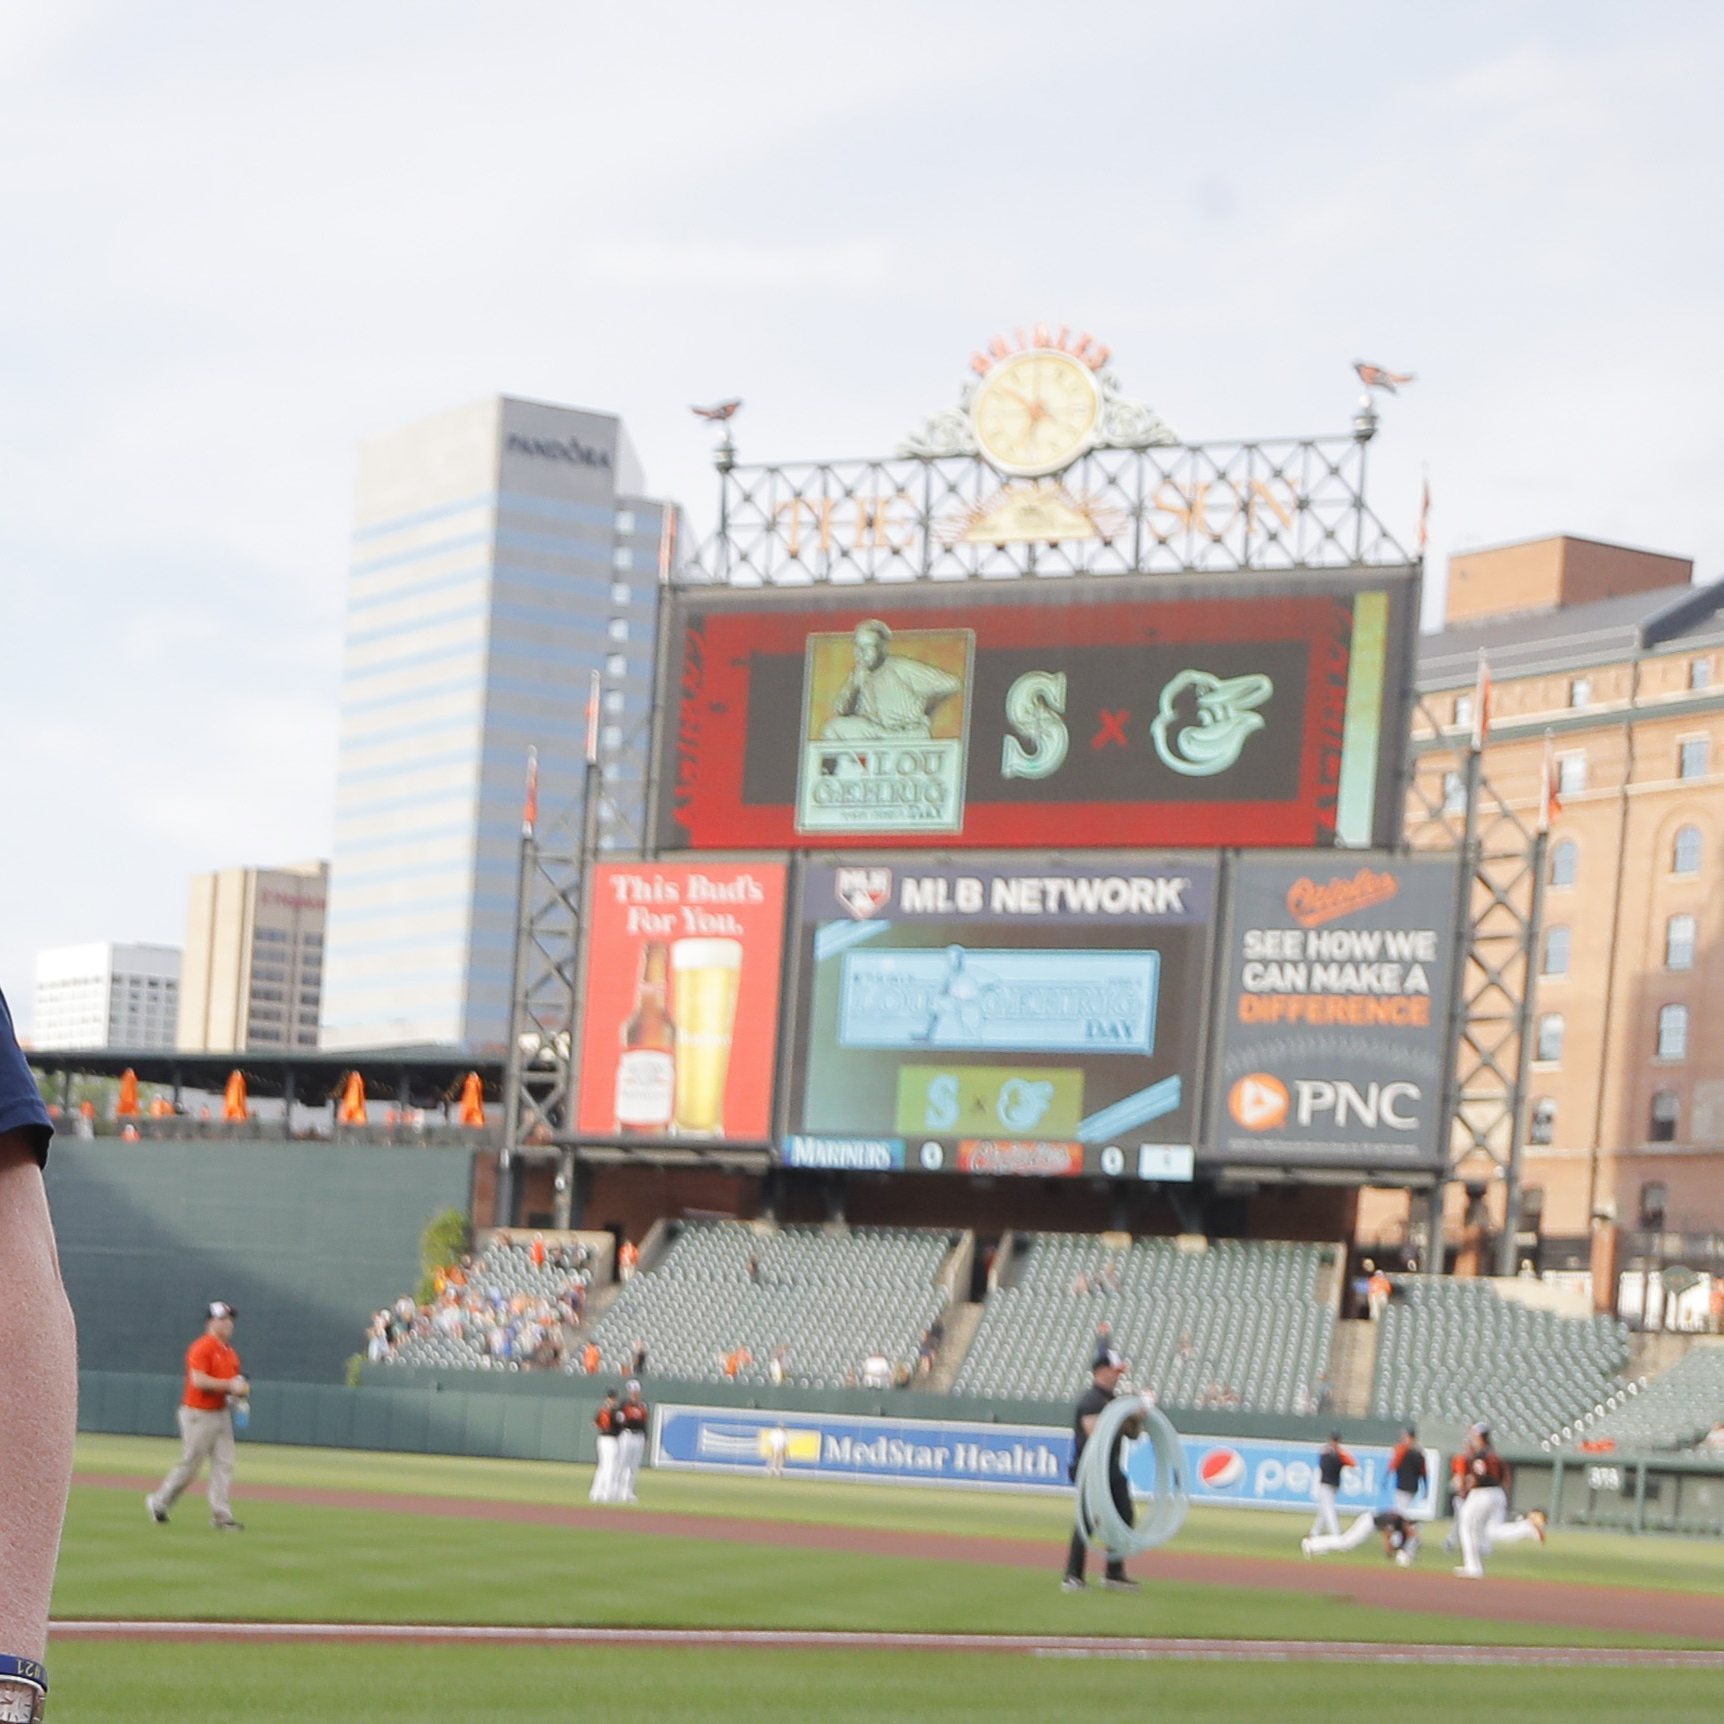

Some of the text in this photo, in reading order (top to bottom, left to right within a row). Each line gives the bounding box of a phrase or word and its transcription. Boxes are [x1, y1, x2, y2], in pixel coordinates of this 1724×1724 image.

[775, 477, 1299, 555] THE SUN
[872, 750, 944, 776] LOU
[610, 874, 763, 903] This Bud's
[901, 877, 984, 914] MLB
[991, 877, 1188, 914] NETWORK
[626, 905, 744, 935] For You.
[1243, 929, 1438, 962] SEE HOW WE
[1242, 962, 1431, 994] CAN MAKE A
[1237, 993, 1431, 1027] DIFFERENCE
[1083, 1018, 1134, 1041] DAY
[1294, 1078, 1422, 1131] PNC
[791, 1136, 892, 1169] MARINERS
[921, 1140, 944, 1171] 0
[1100, 1145, 1125, 1177] 0
[822, 1433, 1059, 1477] MedStar Health
[15, 1658, 42, 1679] #21
